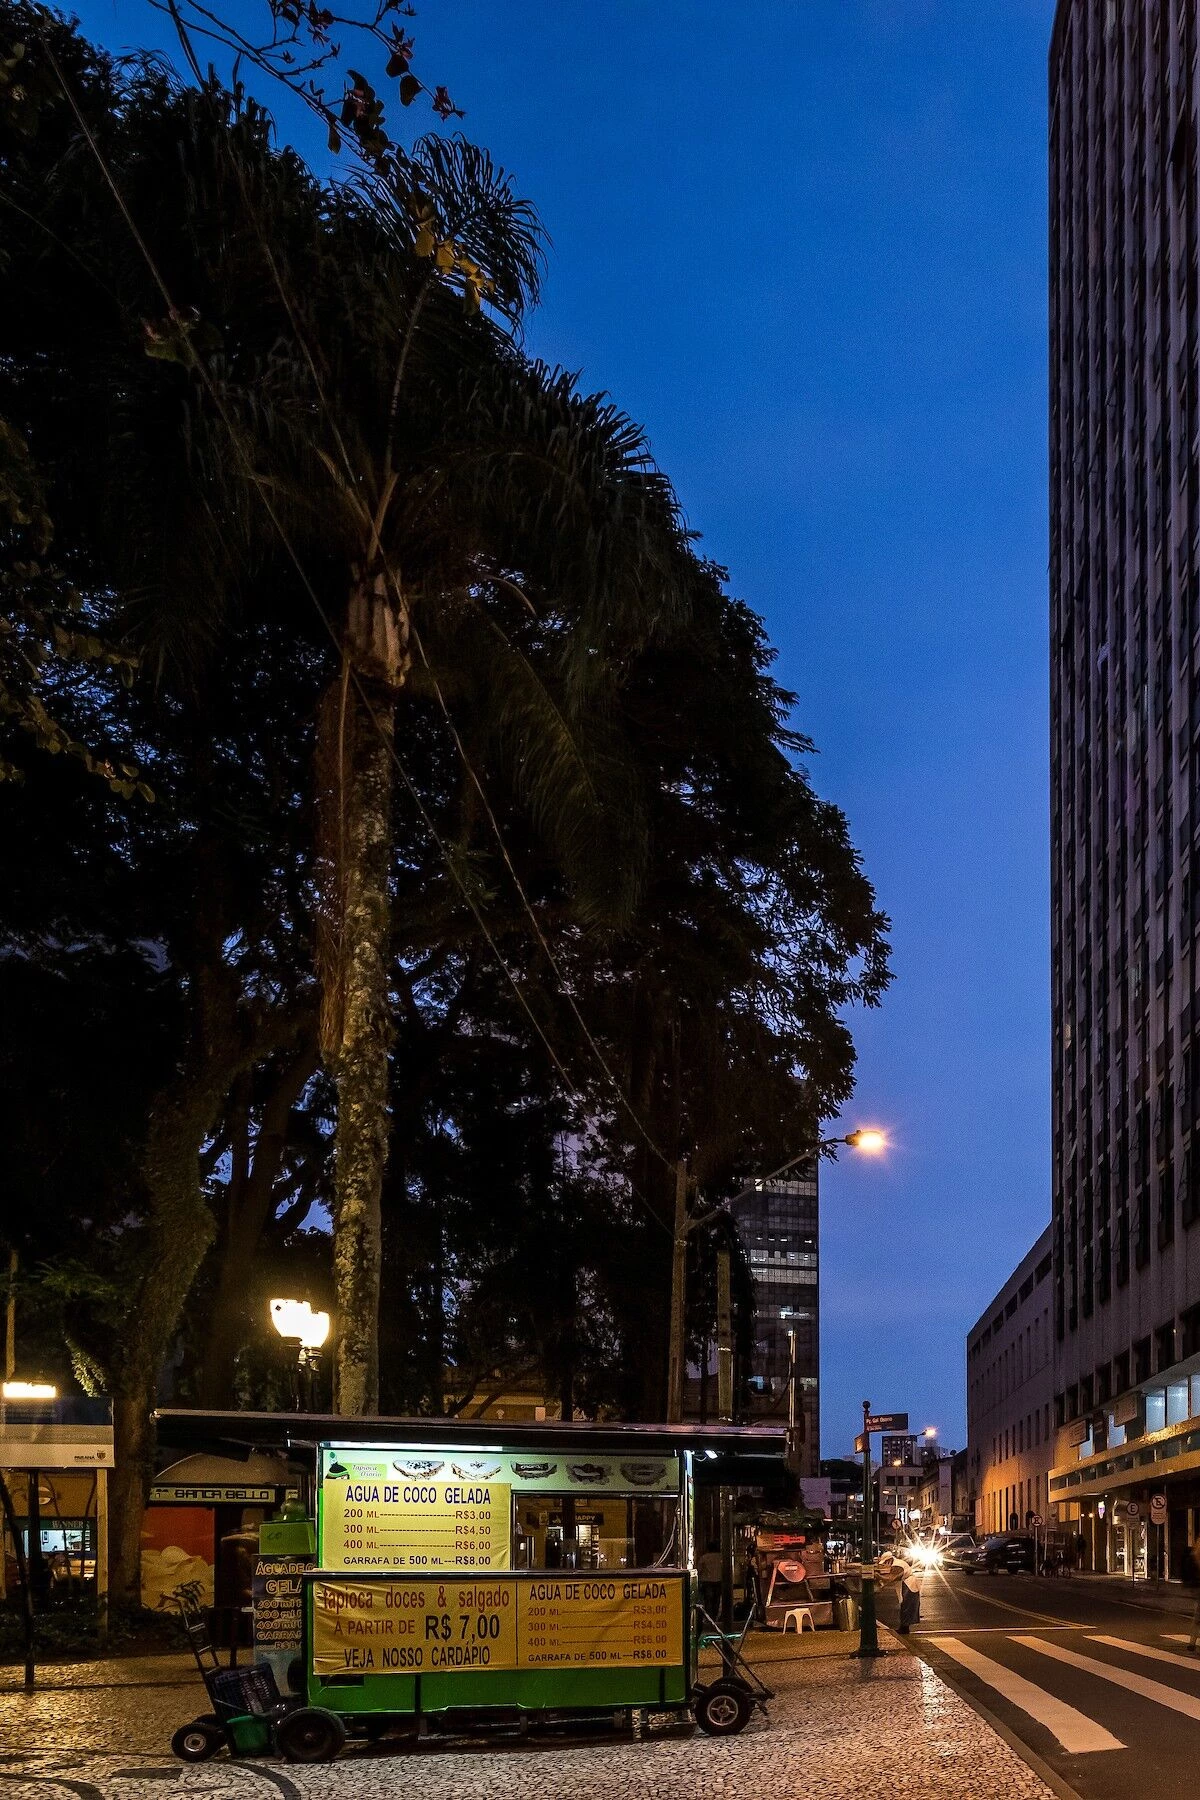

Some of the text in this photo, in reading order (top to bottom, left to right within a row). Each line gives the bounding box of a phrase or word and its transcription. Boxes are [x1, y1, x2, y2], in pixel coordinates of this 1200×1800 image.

[175, 1490, 269, 1500] BANCA BELLO
[345, 1485, 491, 1505] AGUA DE COCO GELADA
[343, 1508, 491, 1520] 200 ML R$3,00
[343, 1524, 491, 1535] 300 ML R$4,50
[343, 1539, 491, 1551] 400 ML R$6,00
[343, 1555, 491, 1566] GARRAFA DE 500 ML R$8,00
[255, 1561, 288, 1575] ÁGUA
[288, 1563, 304, 1575] DE
[529, 1583, 667, 1601] AGUA DE COCO GELADA
[323, 1585, 510, 1613] tapioca doces & salgado
[256, 1610, 279, 1619] 300
[527, 1607, 546, 1616] 200
[256, 1620, 280, 1630] 400
[334, 1614, 500, 1643] A PARTIR DE R$ 7,00
[527, 1622, 546, 1631] 300
[256, 1631, 302, 1640] GARRAF
[527, 1637, 546, 1646] 400
[344, 1640, 491, 1668] VEJA NOSSO CARDÁPIO
[528, 1653, 571, 1662] GARRAFA
[575, 1653, 586, 1661] DE
[589, 1651, 607, 1660] 500
[610, 1652, 622, 1660] ML
